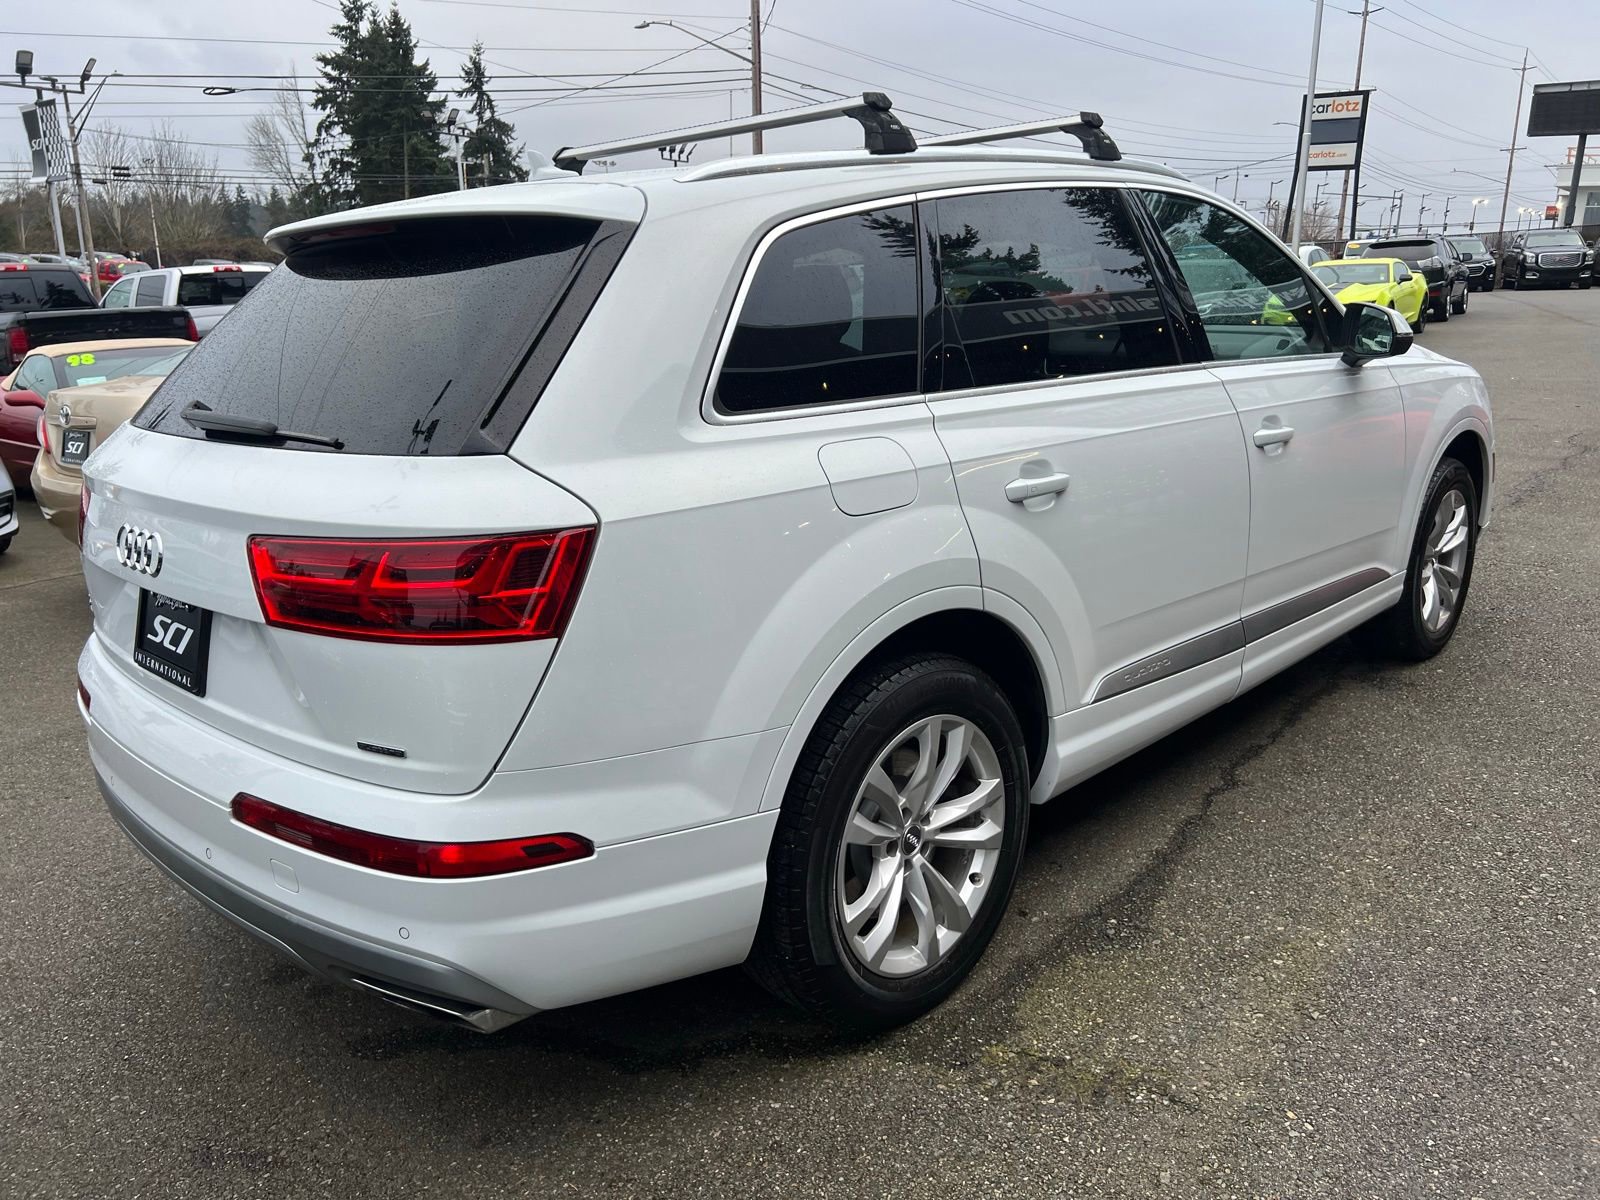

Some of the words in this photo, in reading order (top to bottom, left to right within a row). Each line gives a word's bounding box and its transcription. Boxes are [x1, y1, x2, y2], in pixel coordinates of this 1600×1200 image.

[66, 353, 96, 367] 98
[65, 441, 85, 454] SCI
[147, 614, 194, 655] SCI
[135, 651, 191, 687] INTERNATIONAL
